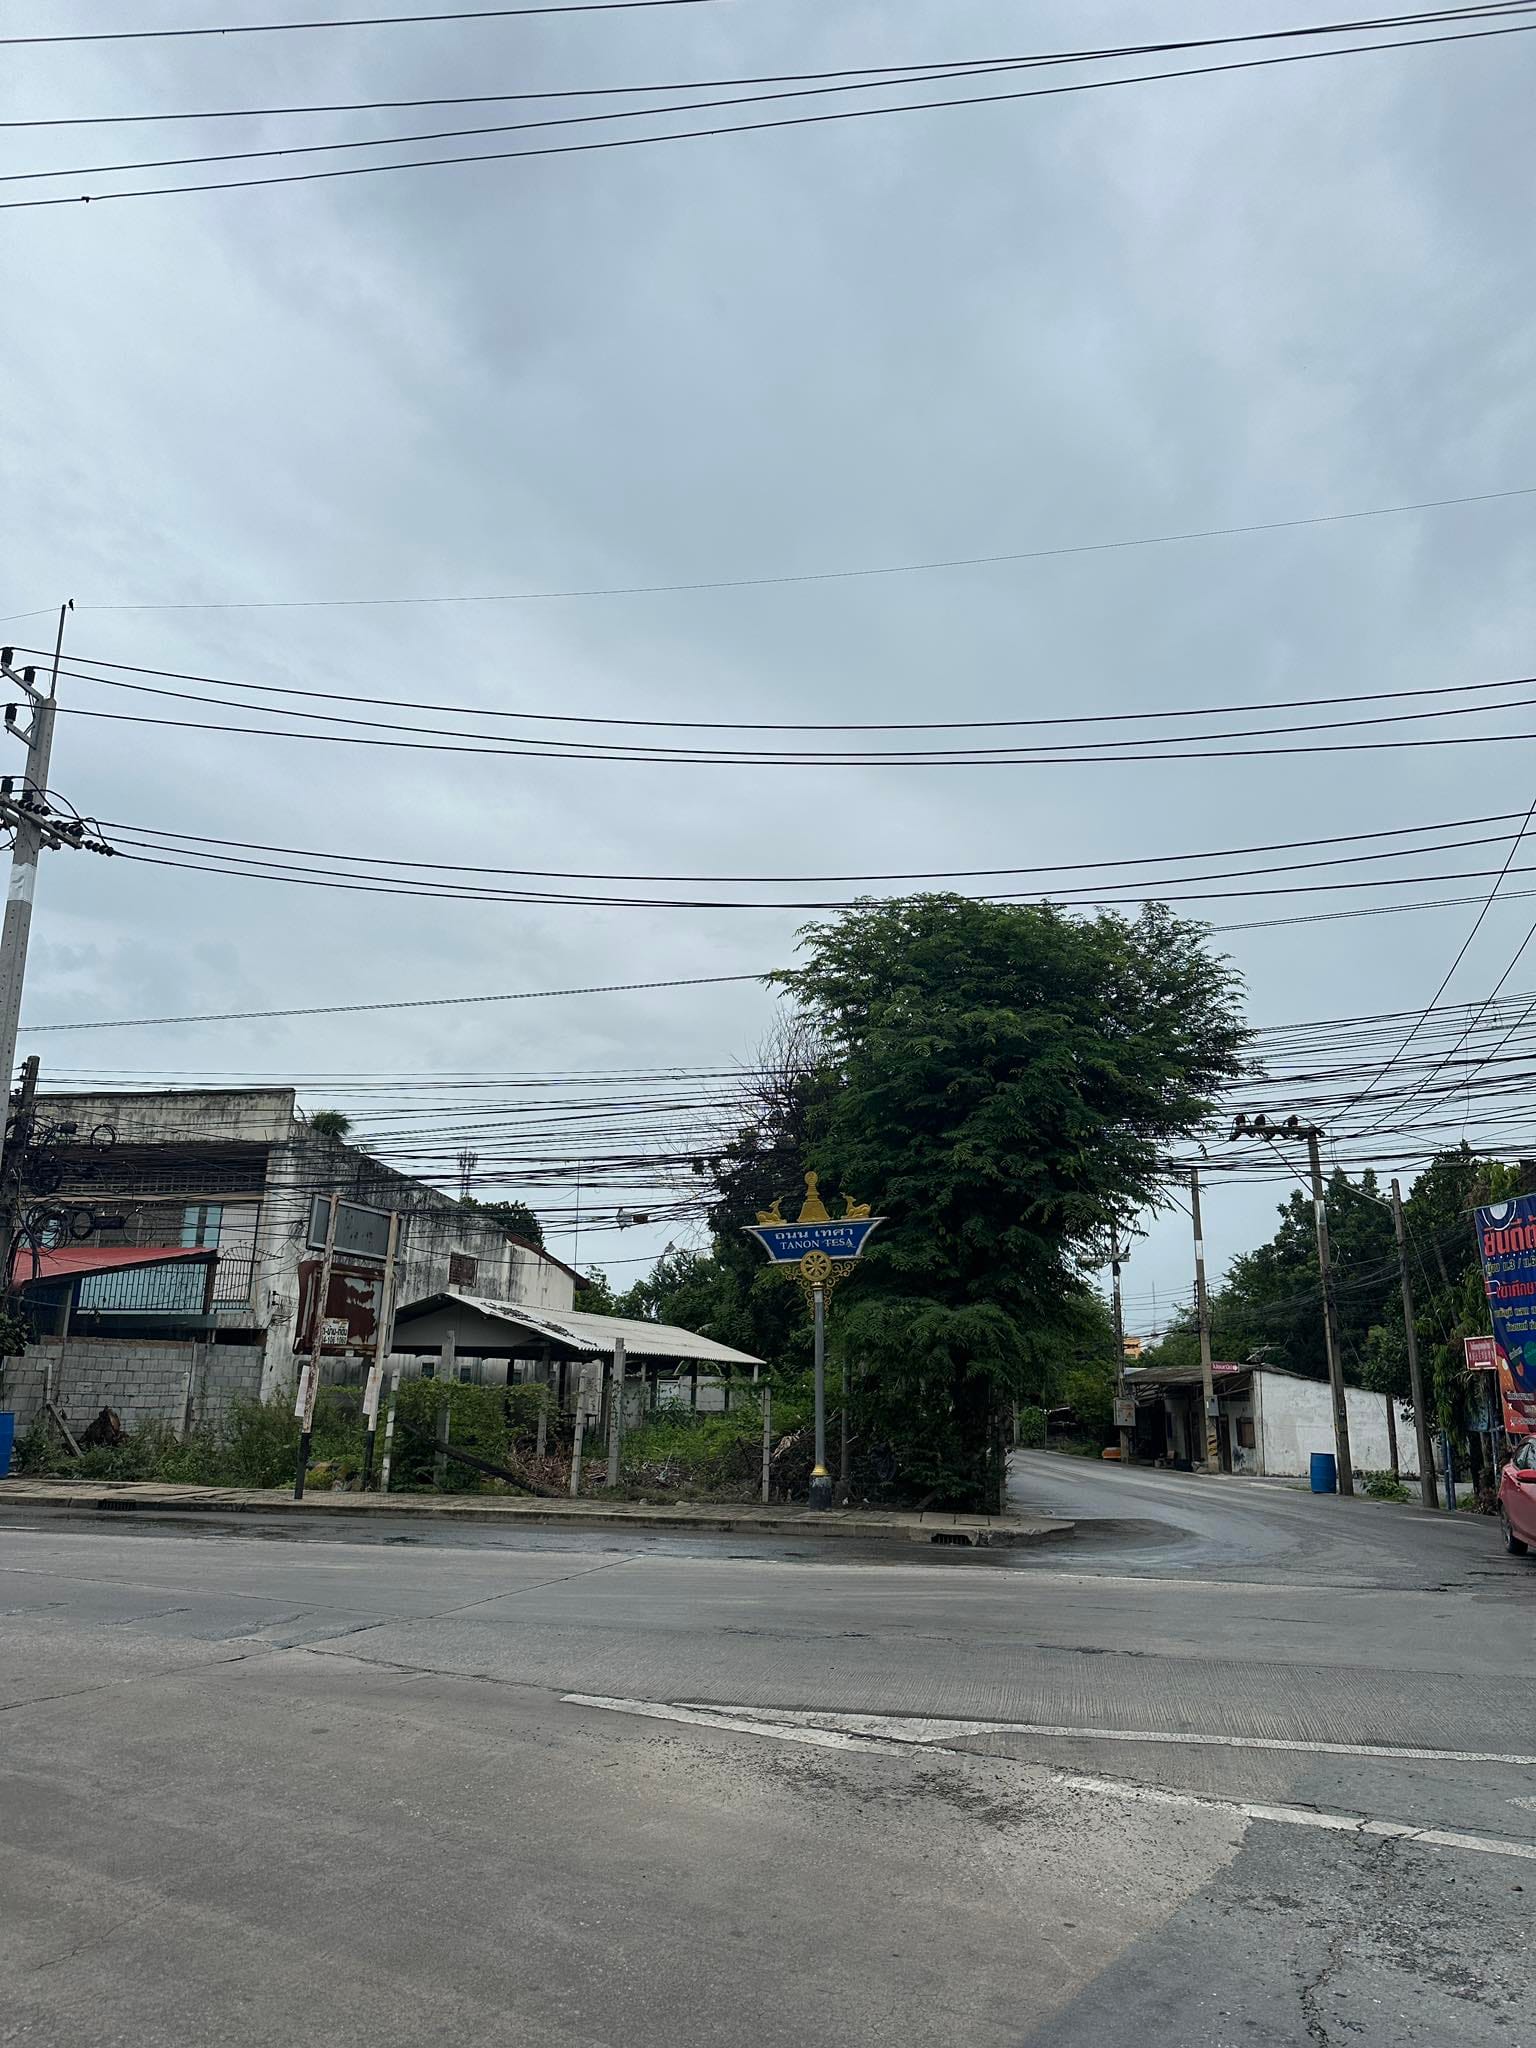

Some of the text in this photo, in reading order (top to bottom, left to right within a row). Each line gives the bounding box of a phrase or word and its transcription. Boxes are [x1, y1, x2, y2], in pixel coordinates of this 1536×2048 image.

[775, 1228, 853, 1240] ถนน เทศา
[780, 1238, 854, 1250] TANON TESA
